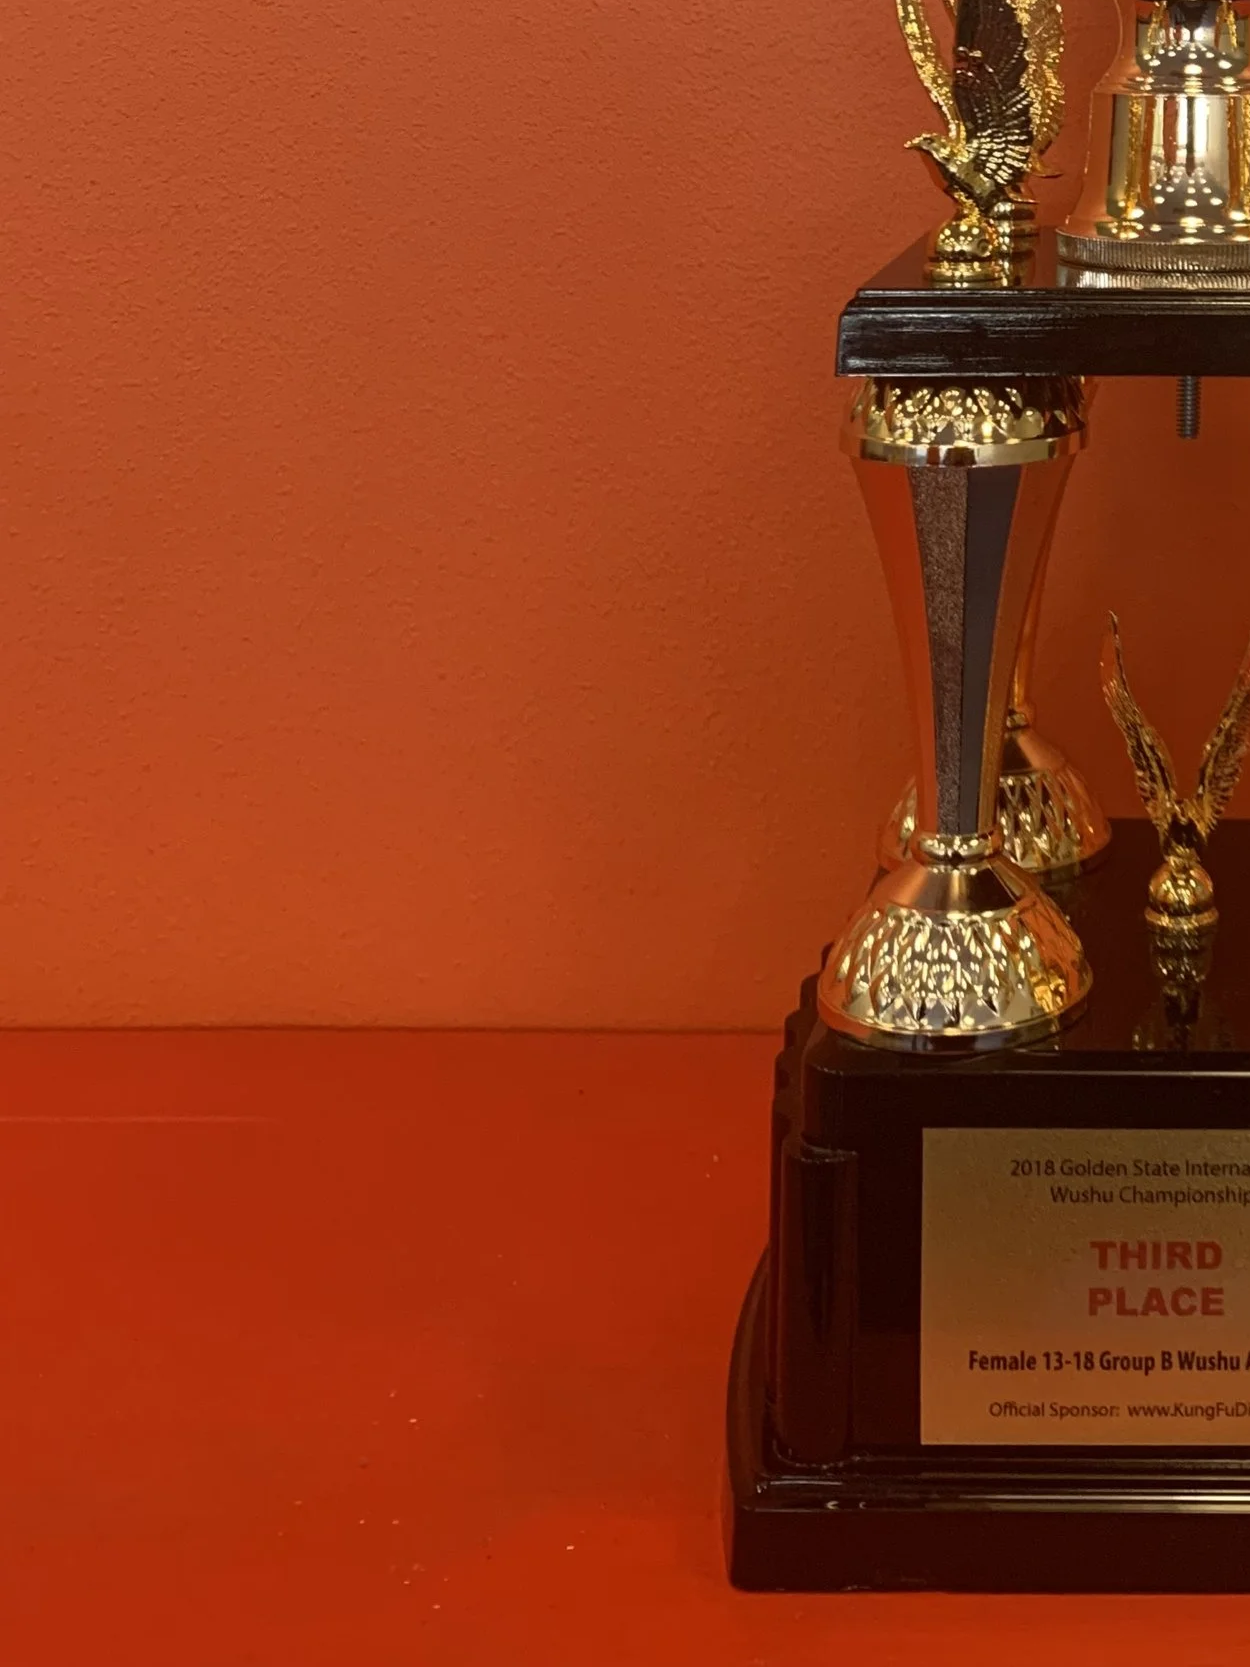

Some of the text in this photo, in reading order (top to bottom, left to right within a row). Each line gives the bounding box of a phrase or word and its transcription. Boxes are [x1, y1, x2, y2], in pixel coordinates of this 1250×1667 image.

[1010, 1159, 1056, 1177] 2018
[1060, 1158, 1127, 1177] Golden
[1133, 1159, 1181, 1177] State
[1050, 1185, 1114, 1204] Wushu
[1089, 1240, 1223, 1271] THIRD
[1088, 1287, 1225, 1317] PLACE
[968, 1350, 1037, 1372] Female
[1042, 1351, 1095, 1372] 13-18
[1100, 1351, 1155, 1376] Group
[1160, 1352, 1173, 1372] B
[1177, 1350, 1241, 1372] Wushu
[989, 1401, 1045, 1418] Official
[1050, 1401, 1120, 1421] Sponsor:
